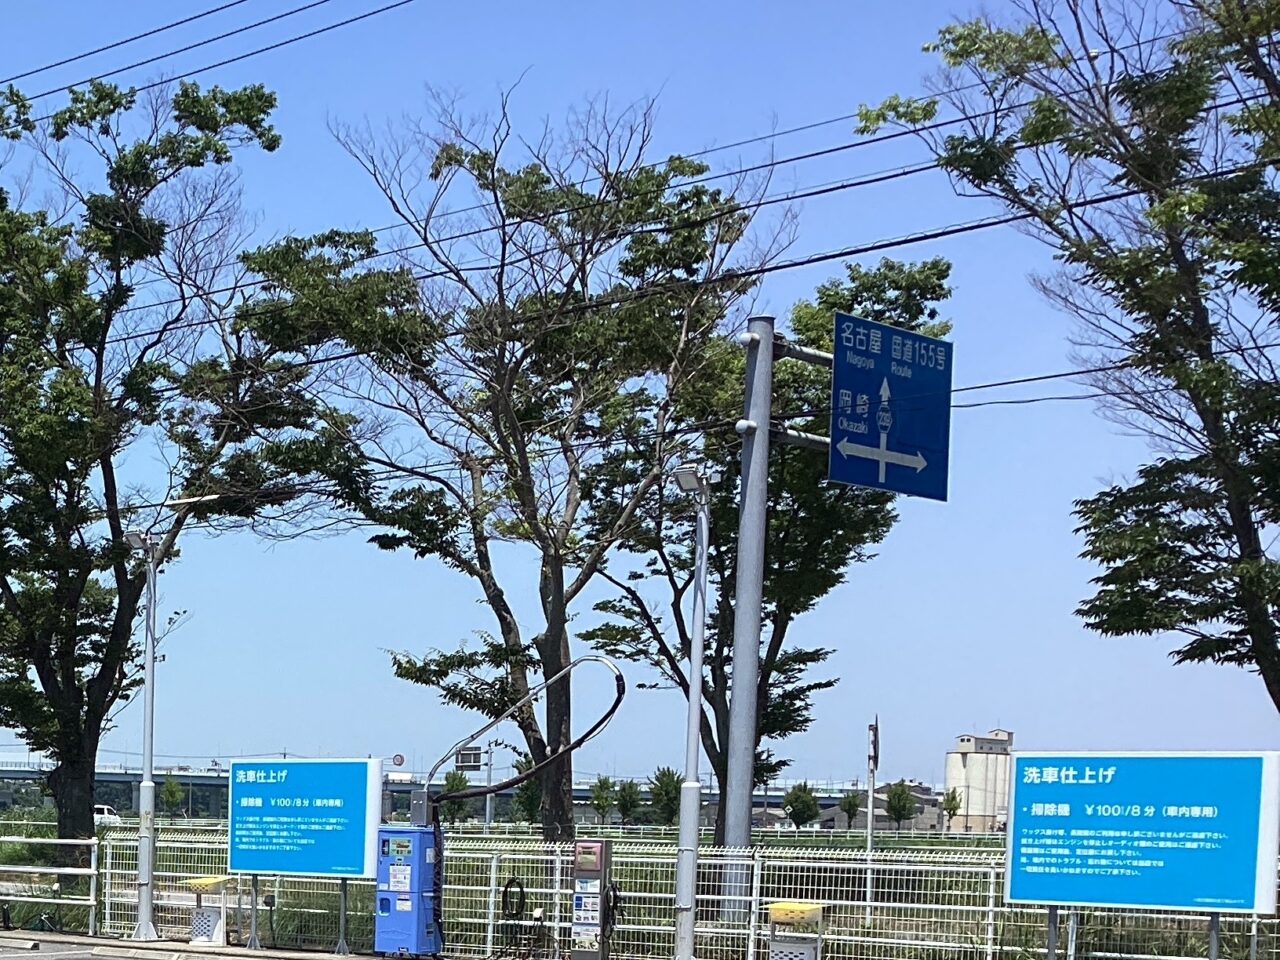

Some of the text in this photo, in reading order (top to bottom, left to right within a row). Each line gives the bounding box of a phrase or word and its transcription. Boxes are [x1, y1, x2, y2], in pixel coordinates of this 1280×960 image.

[841, 322, 882, 354] 名古屋
[846, 350, 875, 370] Nagoya
[838, 416, 869, 434] Okazaki
[235, 769, 288, 783] 洗車仕上げ
[1023, 766, 1117, 784] 洗車仕上げ
